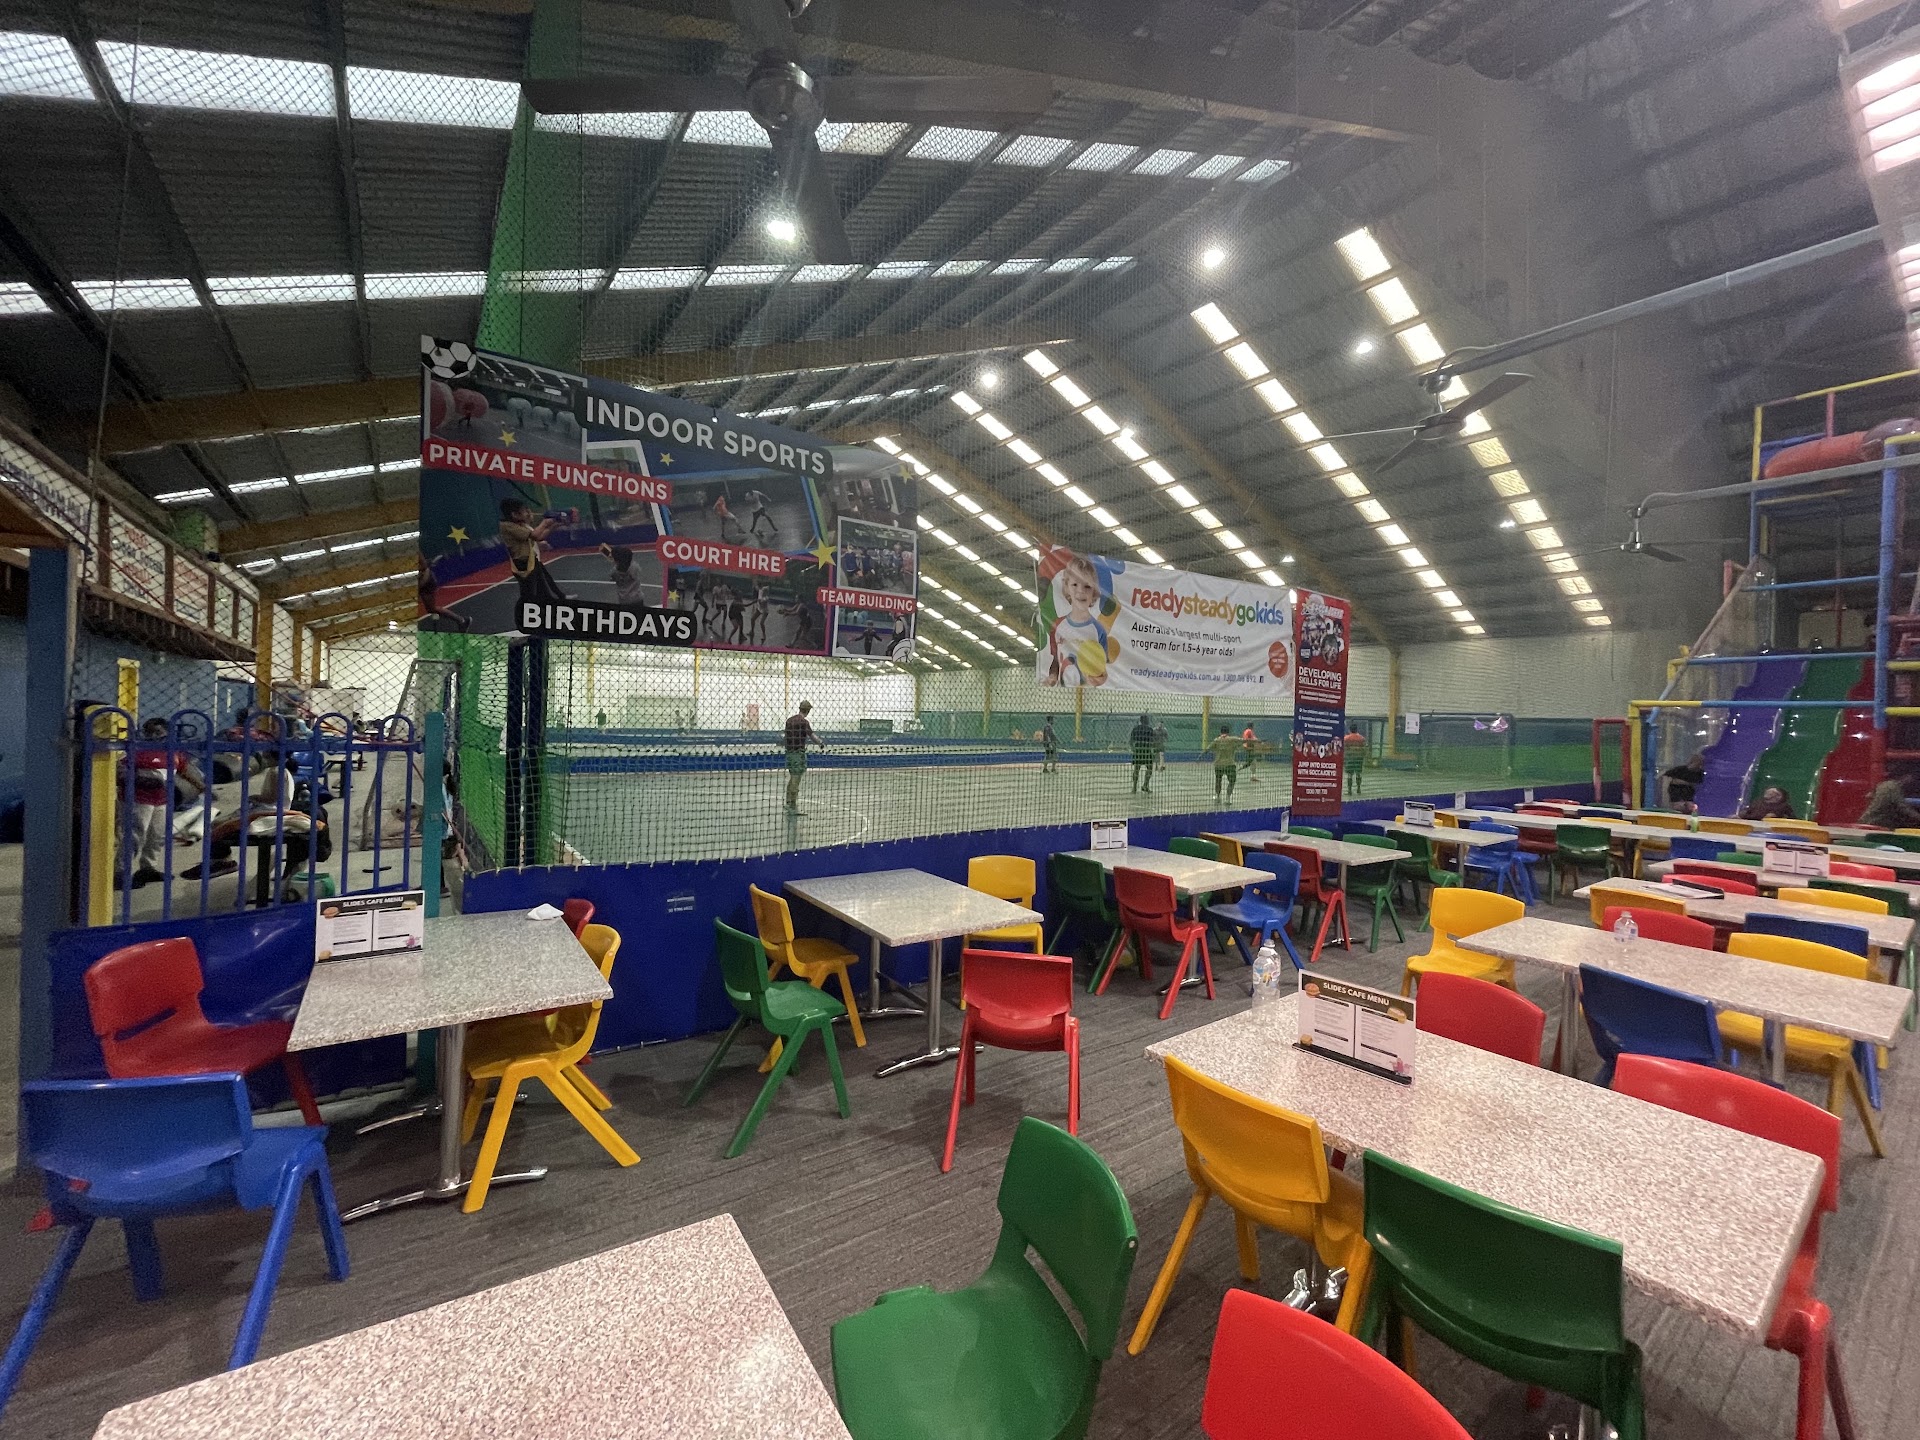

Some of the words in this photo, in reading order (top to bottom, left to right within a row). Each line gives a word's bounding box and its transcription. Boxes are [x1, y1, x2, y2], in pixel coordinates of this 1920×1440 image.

[586, 396, 714, 450] INDOOR
[723, 430, 826, 475] SPORTS
[429, 443, 535, 478] PRIVATE
[543, 462, 668, 500] FUNCTIONS
[662, 540, 732, 566] COURT
[738, 550, 781, 573] HIRE
[820, 589, 857, 605] TEAM
[858, 594, 913, 612] BUILDING
[522, 602, 691, 640] BIRTHDAYS
[1131, 621, 1175, 636] Australia's
[1175, 628, 1201, 640] largest
[1202, 632, 1241, 644] multi-sport
[1131, 639, 1166, 651] program
[1168, 641, 1180, 652] for
[1201, 646, 1217, 656] year
[1218, 647, 1236, 657] olds!
[1130, 668, 1220, 682] readysteadygokids.com.au
[1298, 665, 1342, 682] DEVELOPING
[1298, 676, 1318, 687] SKILLS
[1318, 679, 1330, 688] FOR
[1330, 681, 1342, 690] LIFE
[343, 900, 365, 908] SLIDES
[1323, 982, 1347, 994] SLIDES
[1347, 988, 1367, 1000] CAFE
[1367, 993, 1390, 1006] MENU
